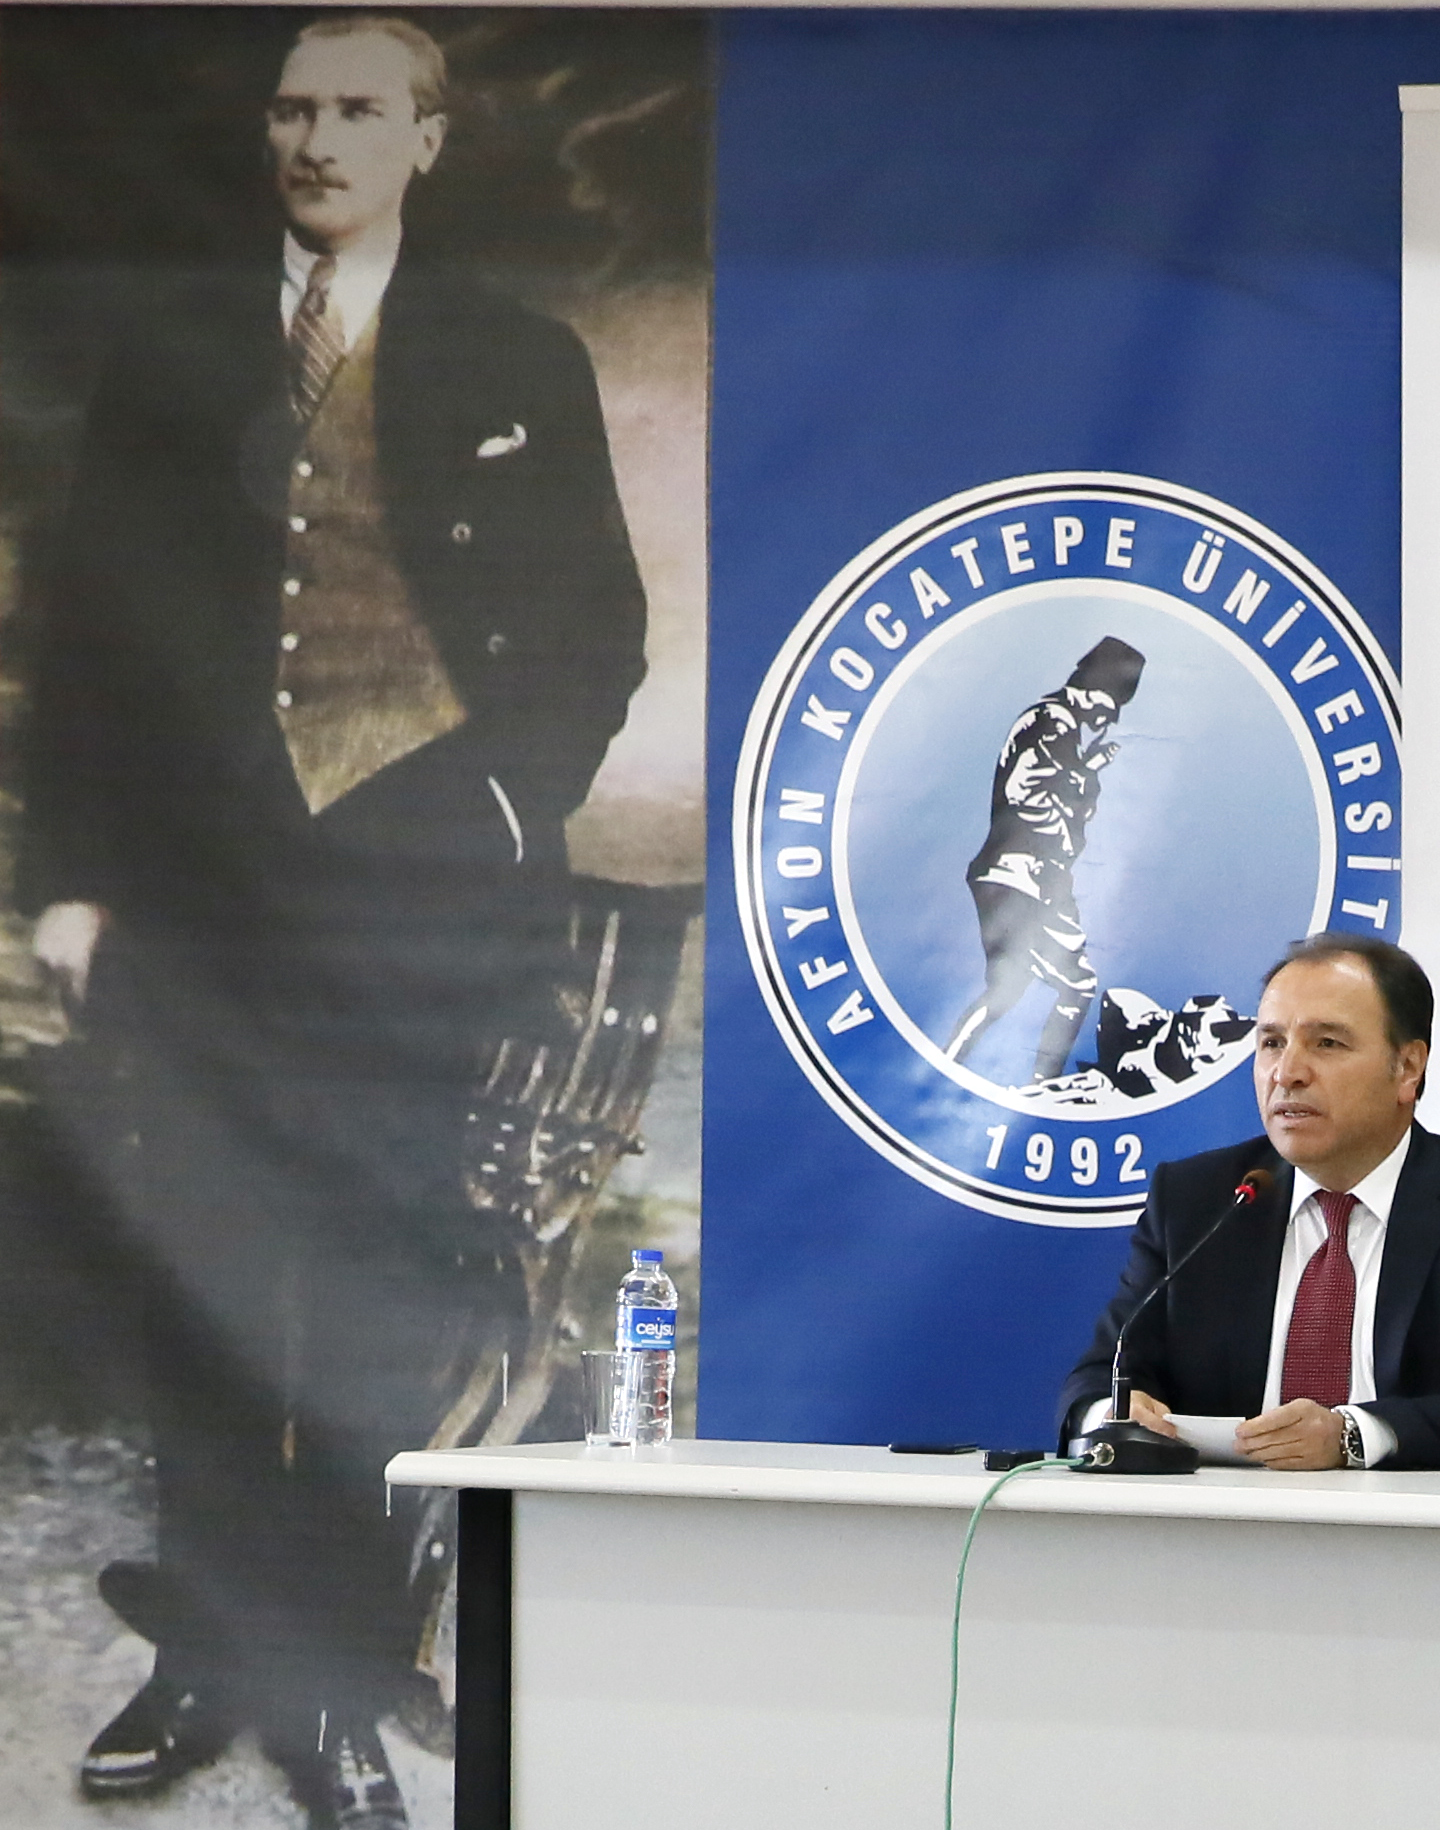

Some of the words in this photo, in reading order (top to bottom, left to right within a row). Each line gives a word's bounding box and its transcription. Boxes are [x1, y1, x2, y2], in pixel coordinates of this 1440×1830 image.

[801, 518, 1137, 742] KOCATEPE
[1182, 530, 1401, 929] ÜNİVERSİT
[776, 788, 875, 1035] AFYON
[986, 1125, 1147, 1186] 1992
